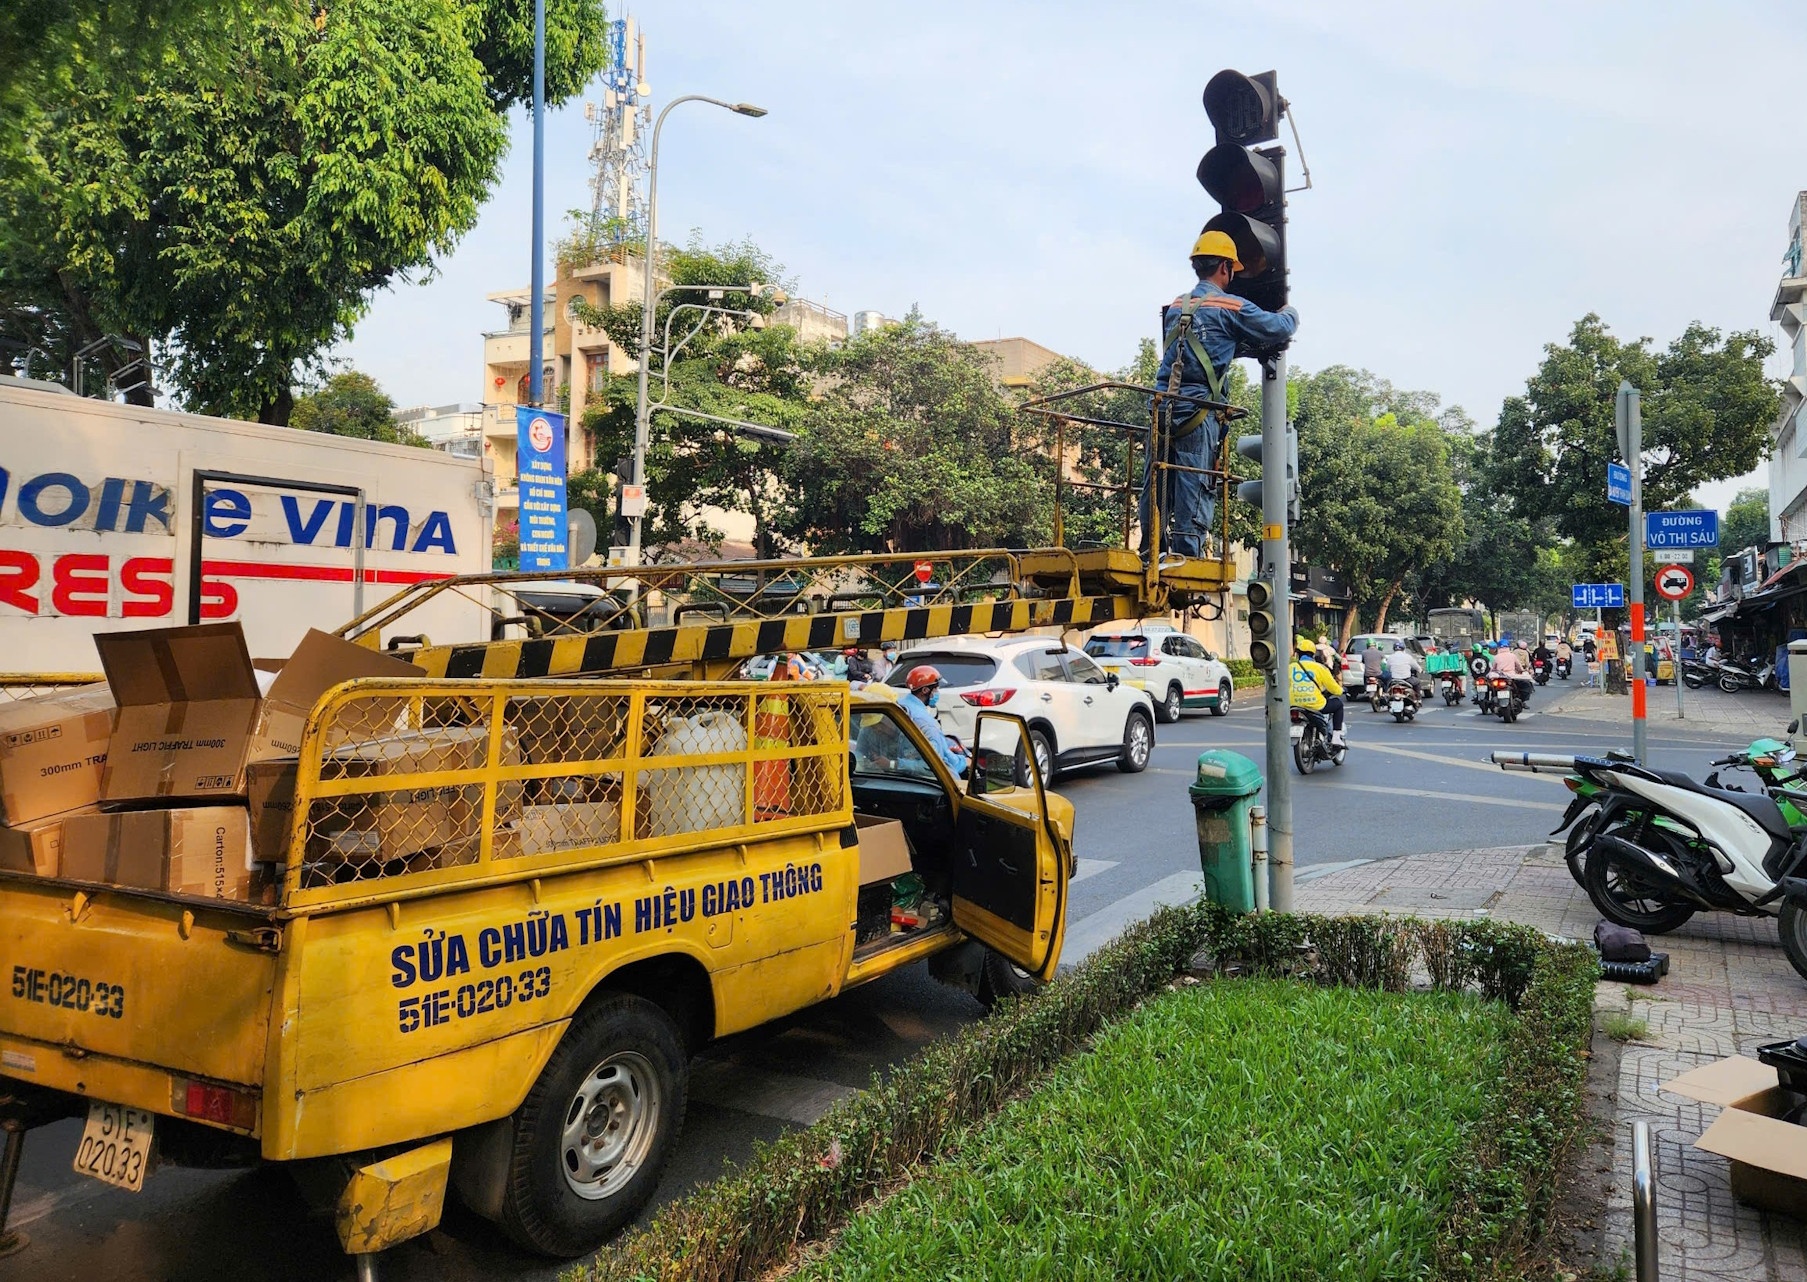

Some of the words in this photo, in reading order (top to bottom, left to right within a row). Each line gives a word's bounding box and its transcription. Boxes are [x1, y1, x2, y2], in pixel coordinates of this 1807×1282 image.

[1661, 515, 1702, 527] ĐƯỜNG
[1650, 531, 1666, 545] VÕ
[1669, 533, 1688, 546] THỊ
[1690, 528, 1715, 544] SÁU
[132, 742, 157, 752] LIGHT
[158, 740, 194, 751] TRAFFIC
[196, 738, 226, 748] 300mm
[40, 762, 82, 777] 300mm
[391, 928, 470, 988] SỬA
[479, 910, 569, 968] CHỮA
[575, 898, 621, 946] TÍN
[635, 885, 695, 934] HIỆU
[702, 877, 755, 917] GIAO
[759, 862, 823, 904] THÔNG
[101, 1105, 137, 1143] 51E
[77, 1136, 142, 1184] 020.33
